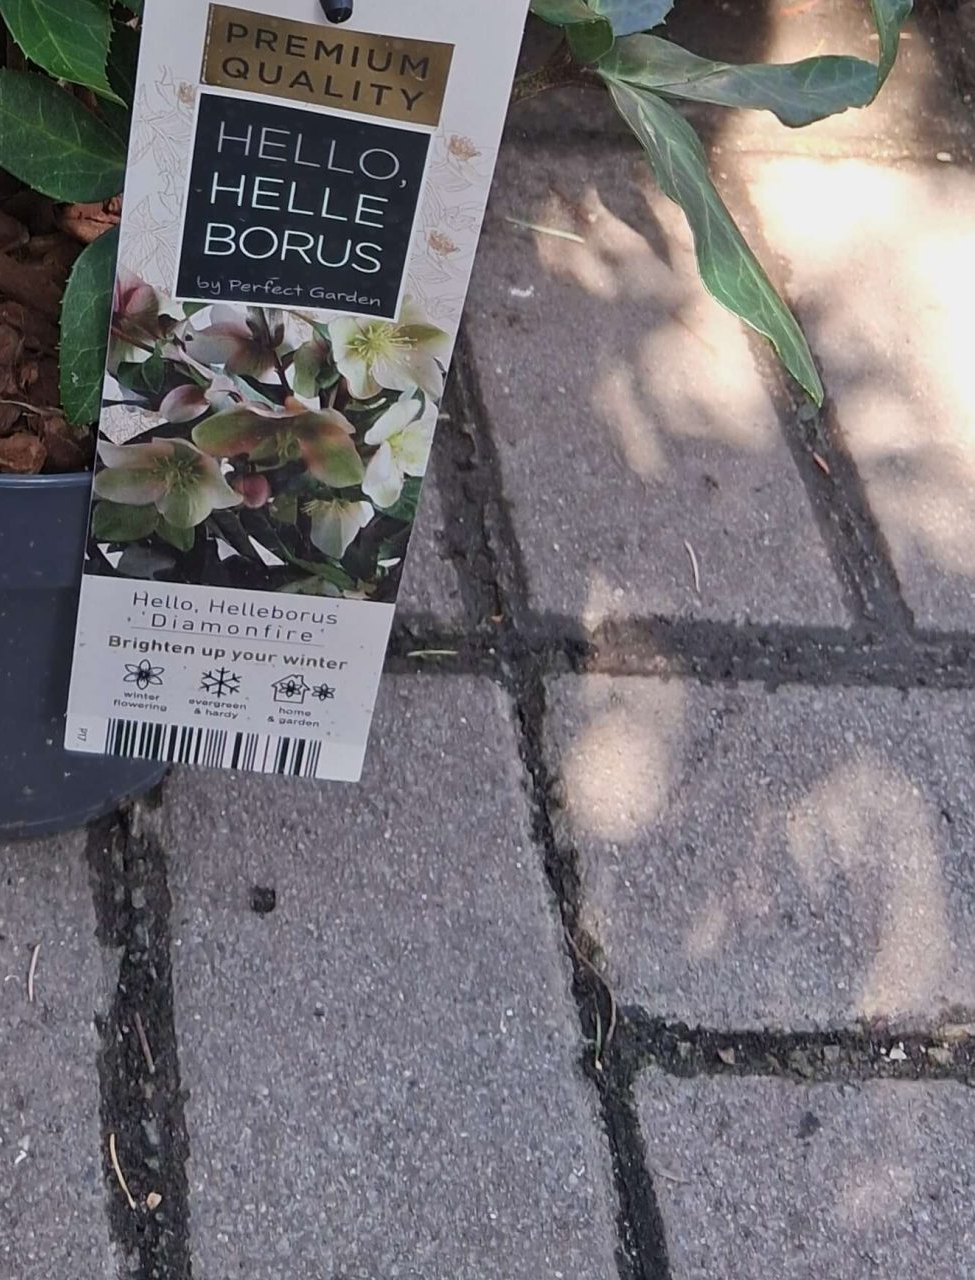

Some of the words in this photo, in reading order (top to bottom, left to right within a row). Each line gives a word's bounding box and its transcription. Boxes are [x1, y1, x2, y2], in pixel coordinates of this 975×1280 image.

[226, 21, 430, 79] PREMIUM
[221, 56, 426, 112] QUALITY
[217, 120, 407, 189] HELLO,
[210, 171, 389, 228] HELLE
[203, 222, 384, 273] BORUS
[196, 275, 221, 295] by
[228, 276, 304, 298] Perfect
[309, 286, 382, 308] Garden
[132, 591, 200, 614] Hello,
[209, 598, 338, 625] Helleborus
[108, 634, 196, 657] Brighten
[201, 646, 226, 660] up
[231, 648, 277, 664] your
[282, 653, 349, 671] winter
[113, 698, 168, 713] flowering
[123, 691, 161, 702] winter
[188, 698, 247, 711] evergreen
[278, 706, 312, 718] home
[204, 708, 239, 720] hardy
[278, 716, 320, 728] garden
